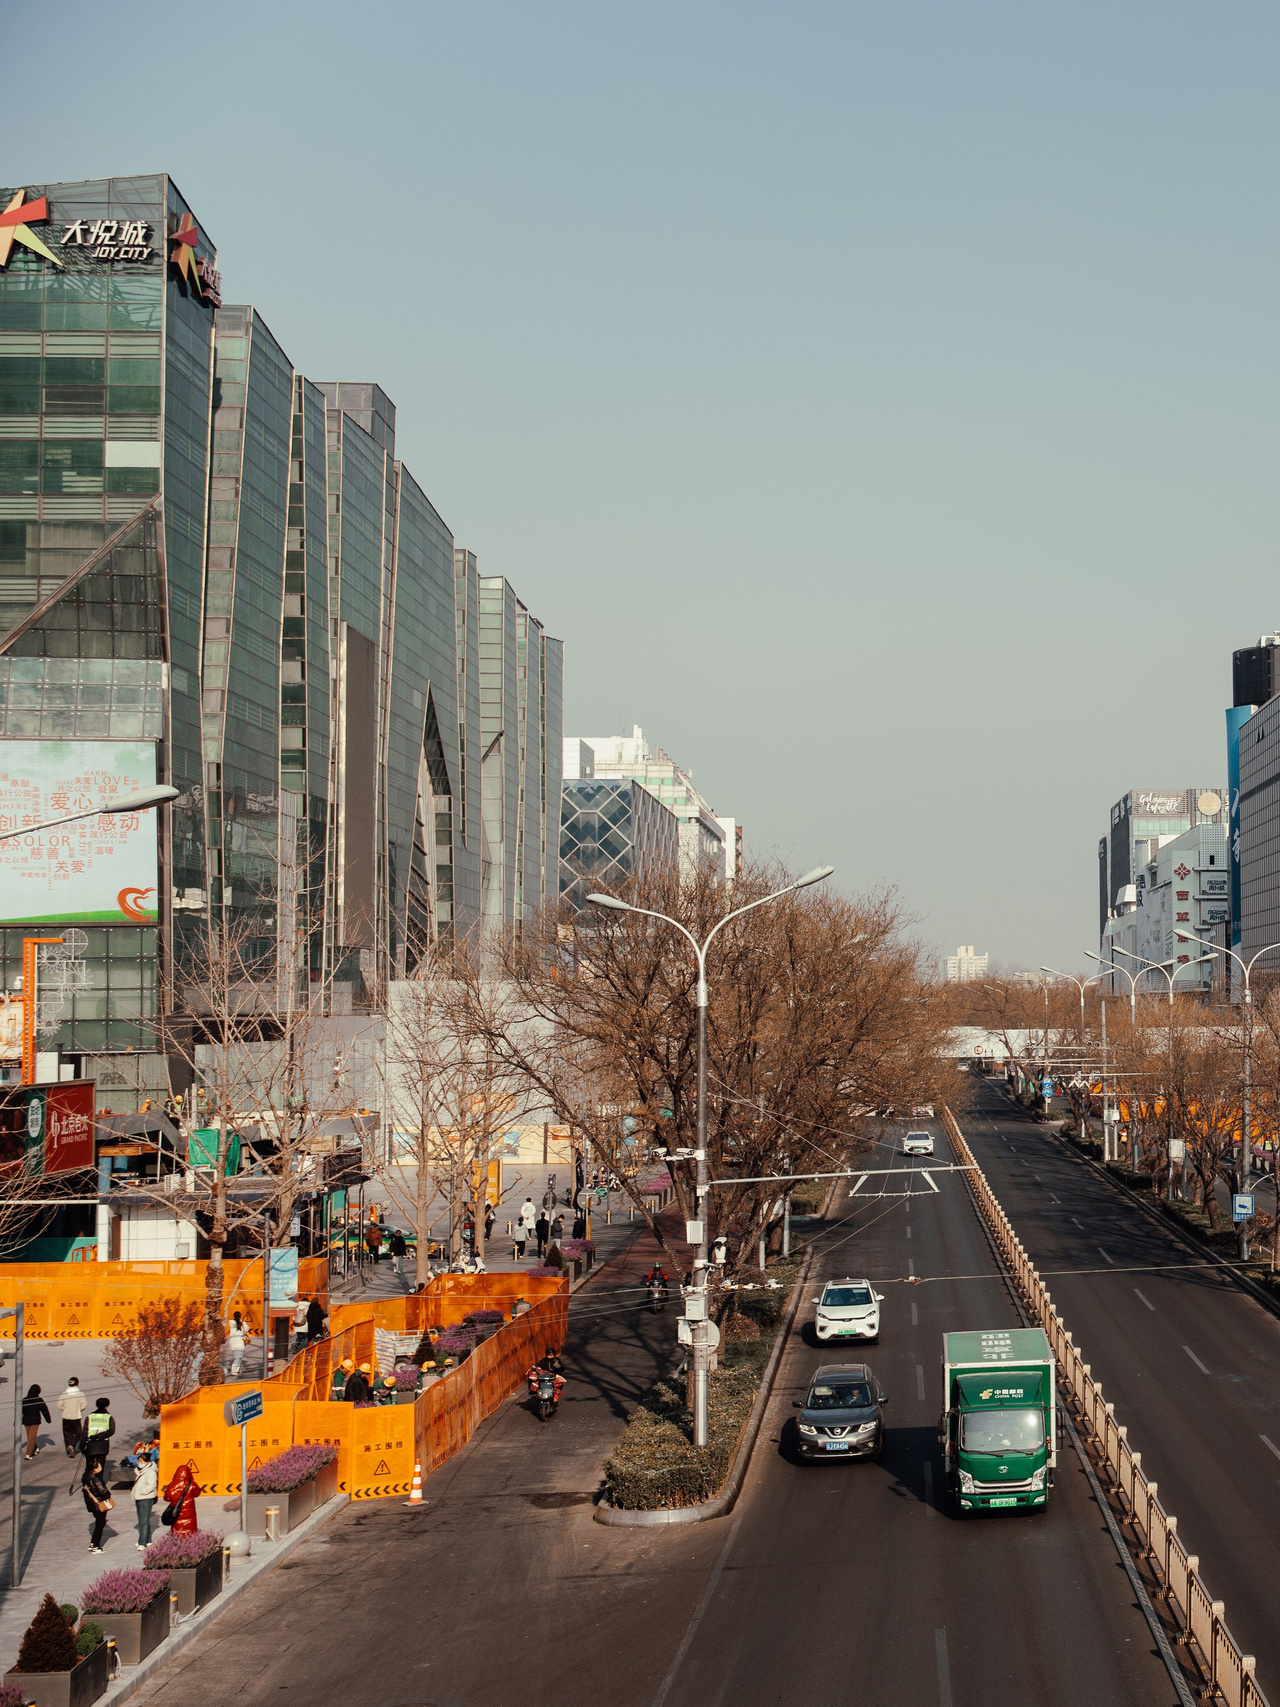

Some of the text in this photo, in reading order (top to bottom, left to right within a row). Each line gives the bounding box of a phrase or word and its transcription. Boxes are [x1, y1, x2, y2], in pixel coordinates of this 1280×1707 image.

[61, 219, 149, 246] 大悦城
[91, 247, 152, 260] JOY CITY
[94, 776, 130, 785] LOVE
[51, 792, 93, 811] 爱心
[97, 813, 140, 832] 感动
[12, 834, 71, 847] SOLOR
[30, 846, 60, 860] 慈善
[55, 859, 85, 874] 关爱
[172, 1440, 213, 1450] 施工围挡
[363, 1441, 404, 1453] 施工围挡
